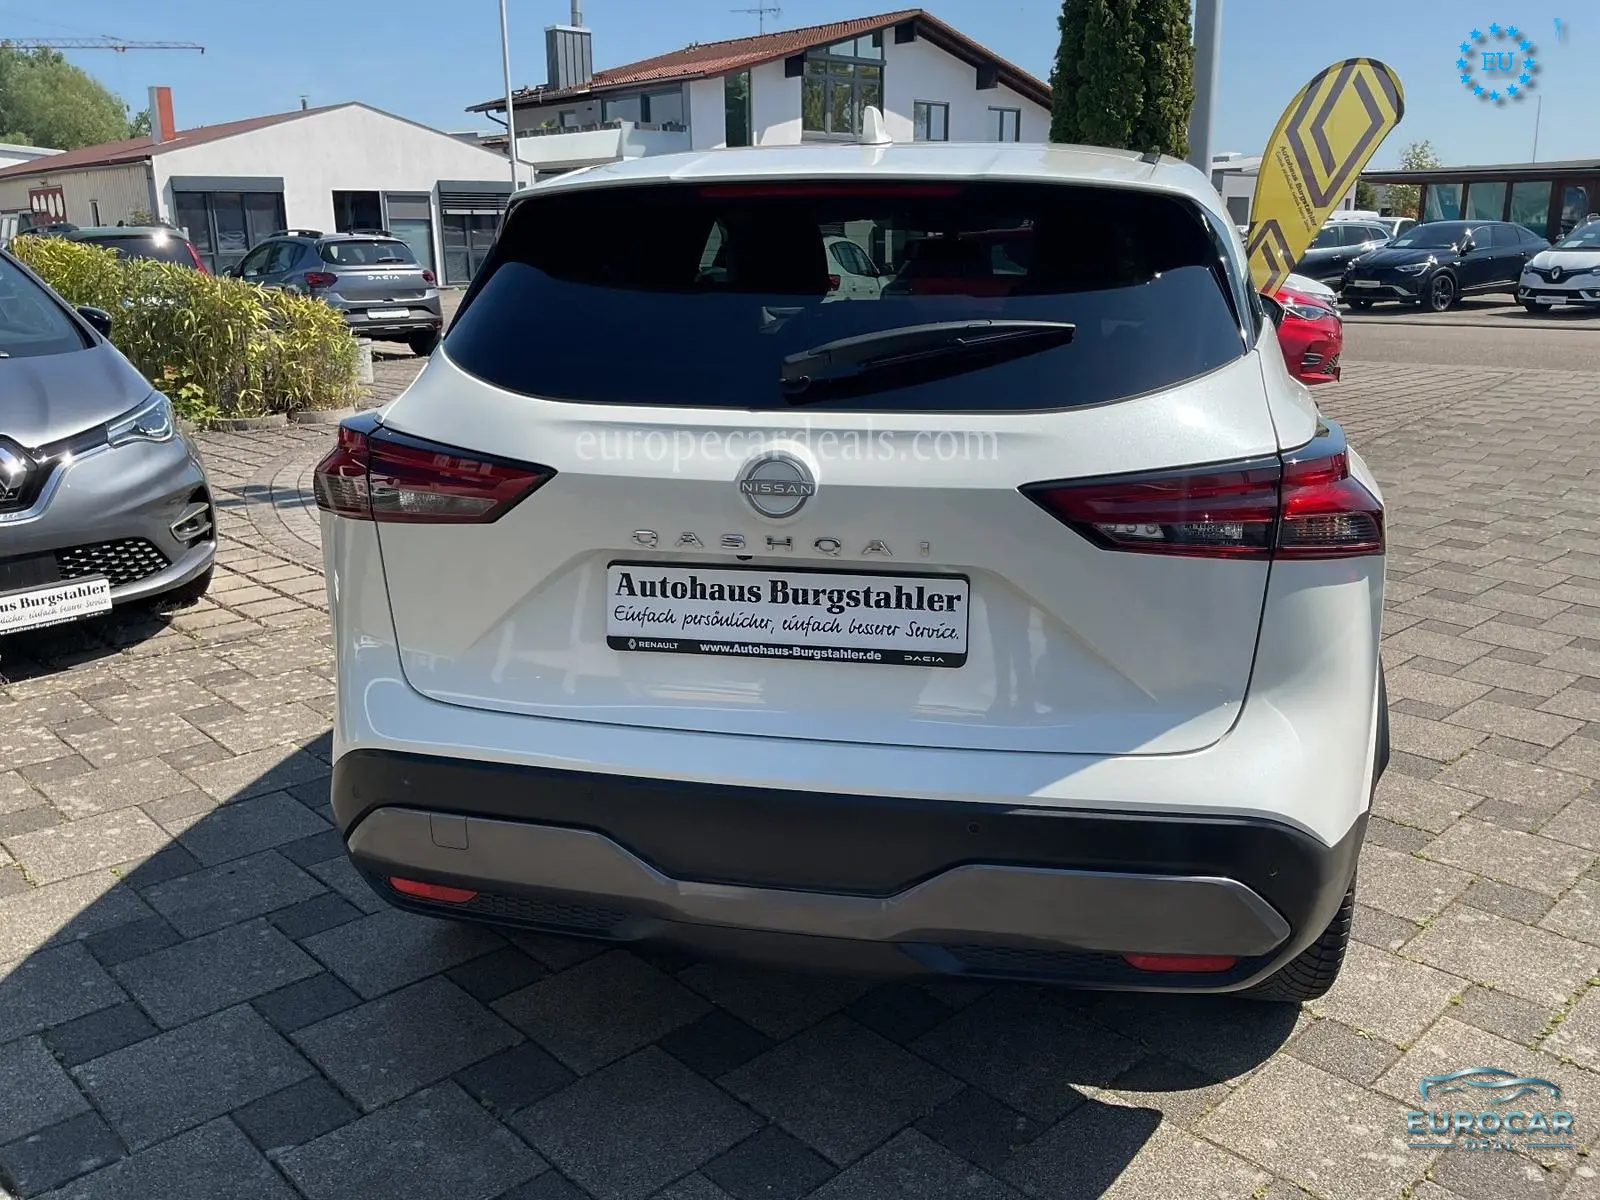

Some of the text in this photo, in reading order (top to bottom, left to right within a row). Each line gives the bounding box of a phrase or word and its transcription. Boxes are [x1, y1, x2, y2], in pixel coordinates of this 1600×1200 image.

[741, 480, 812, 495] NISSAN
[631, 529, 931, 557] QASHQAI
[19, 584, 107, 609] Burgstahler
[615, 572, 962, 615] Autohaus Burgstahler
[614, 605, 960, 640] Einfach persönlicher, einfach besserer Service.
[638, 641, 679, 649] RENAULT
[699, 643, 882, 661] www.Autohaus-Burgstahler.de
[903, 655, 945, 663] DACIA
